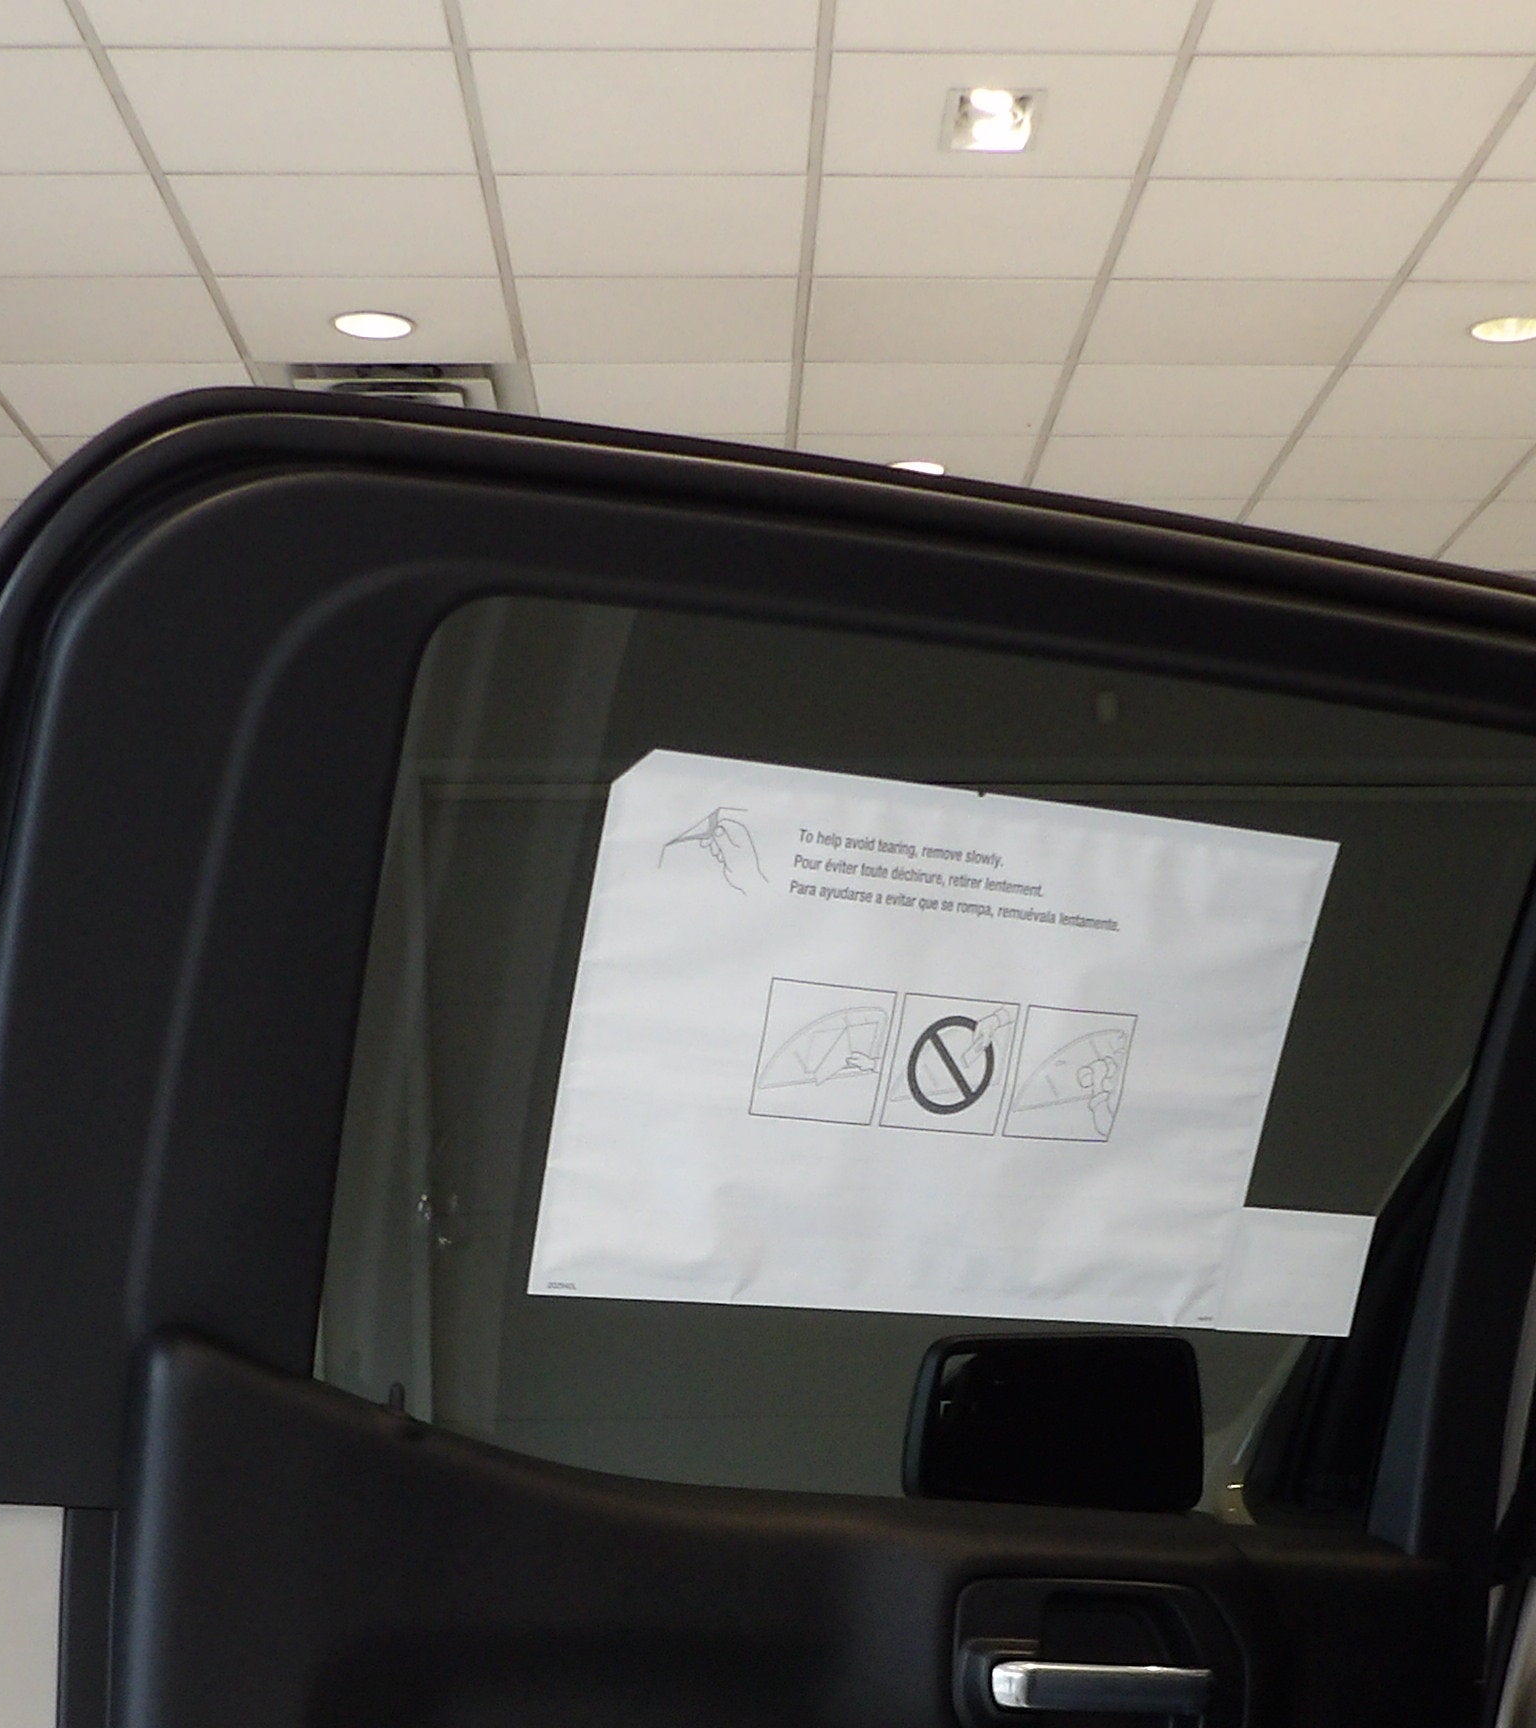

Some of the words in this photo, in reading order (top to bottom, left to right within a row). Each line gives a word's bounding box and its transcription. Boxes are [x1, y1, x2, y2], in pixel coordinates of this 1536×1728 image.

[799, 828, 814, 843] To
[816, 831, 842, 850] help
[845, 836, 875, 851] avoid
[878, 839, 917, 859] tearing,
[922, 846, 962, 862] remove
[965, 849, 1004, 868] slowly.
[794, 854, 822, 871] Pour
[825, 859, 859, 876] éviter
[861, 863, 888, 879] toute
[891, 867, 945, 888] déchirure,
[948, 874, 983, 890] retirer
[985, 877, 1044, 898] lentement.
[789, 880, 816, 896] Para
[819, 885, 873, 904] ayudarse
[885, 893, 916, 907] evitar
[918, 898, 939, 911] que
[941, 900, 954, 911] se
[956, 901, 994, 918] rompa,
[997, 907, 1056, 925] remuévala
